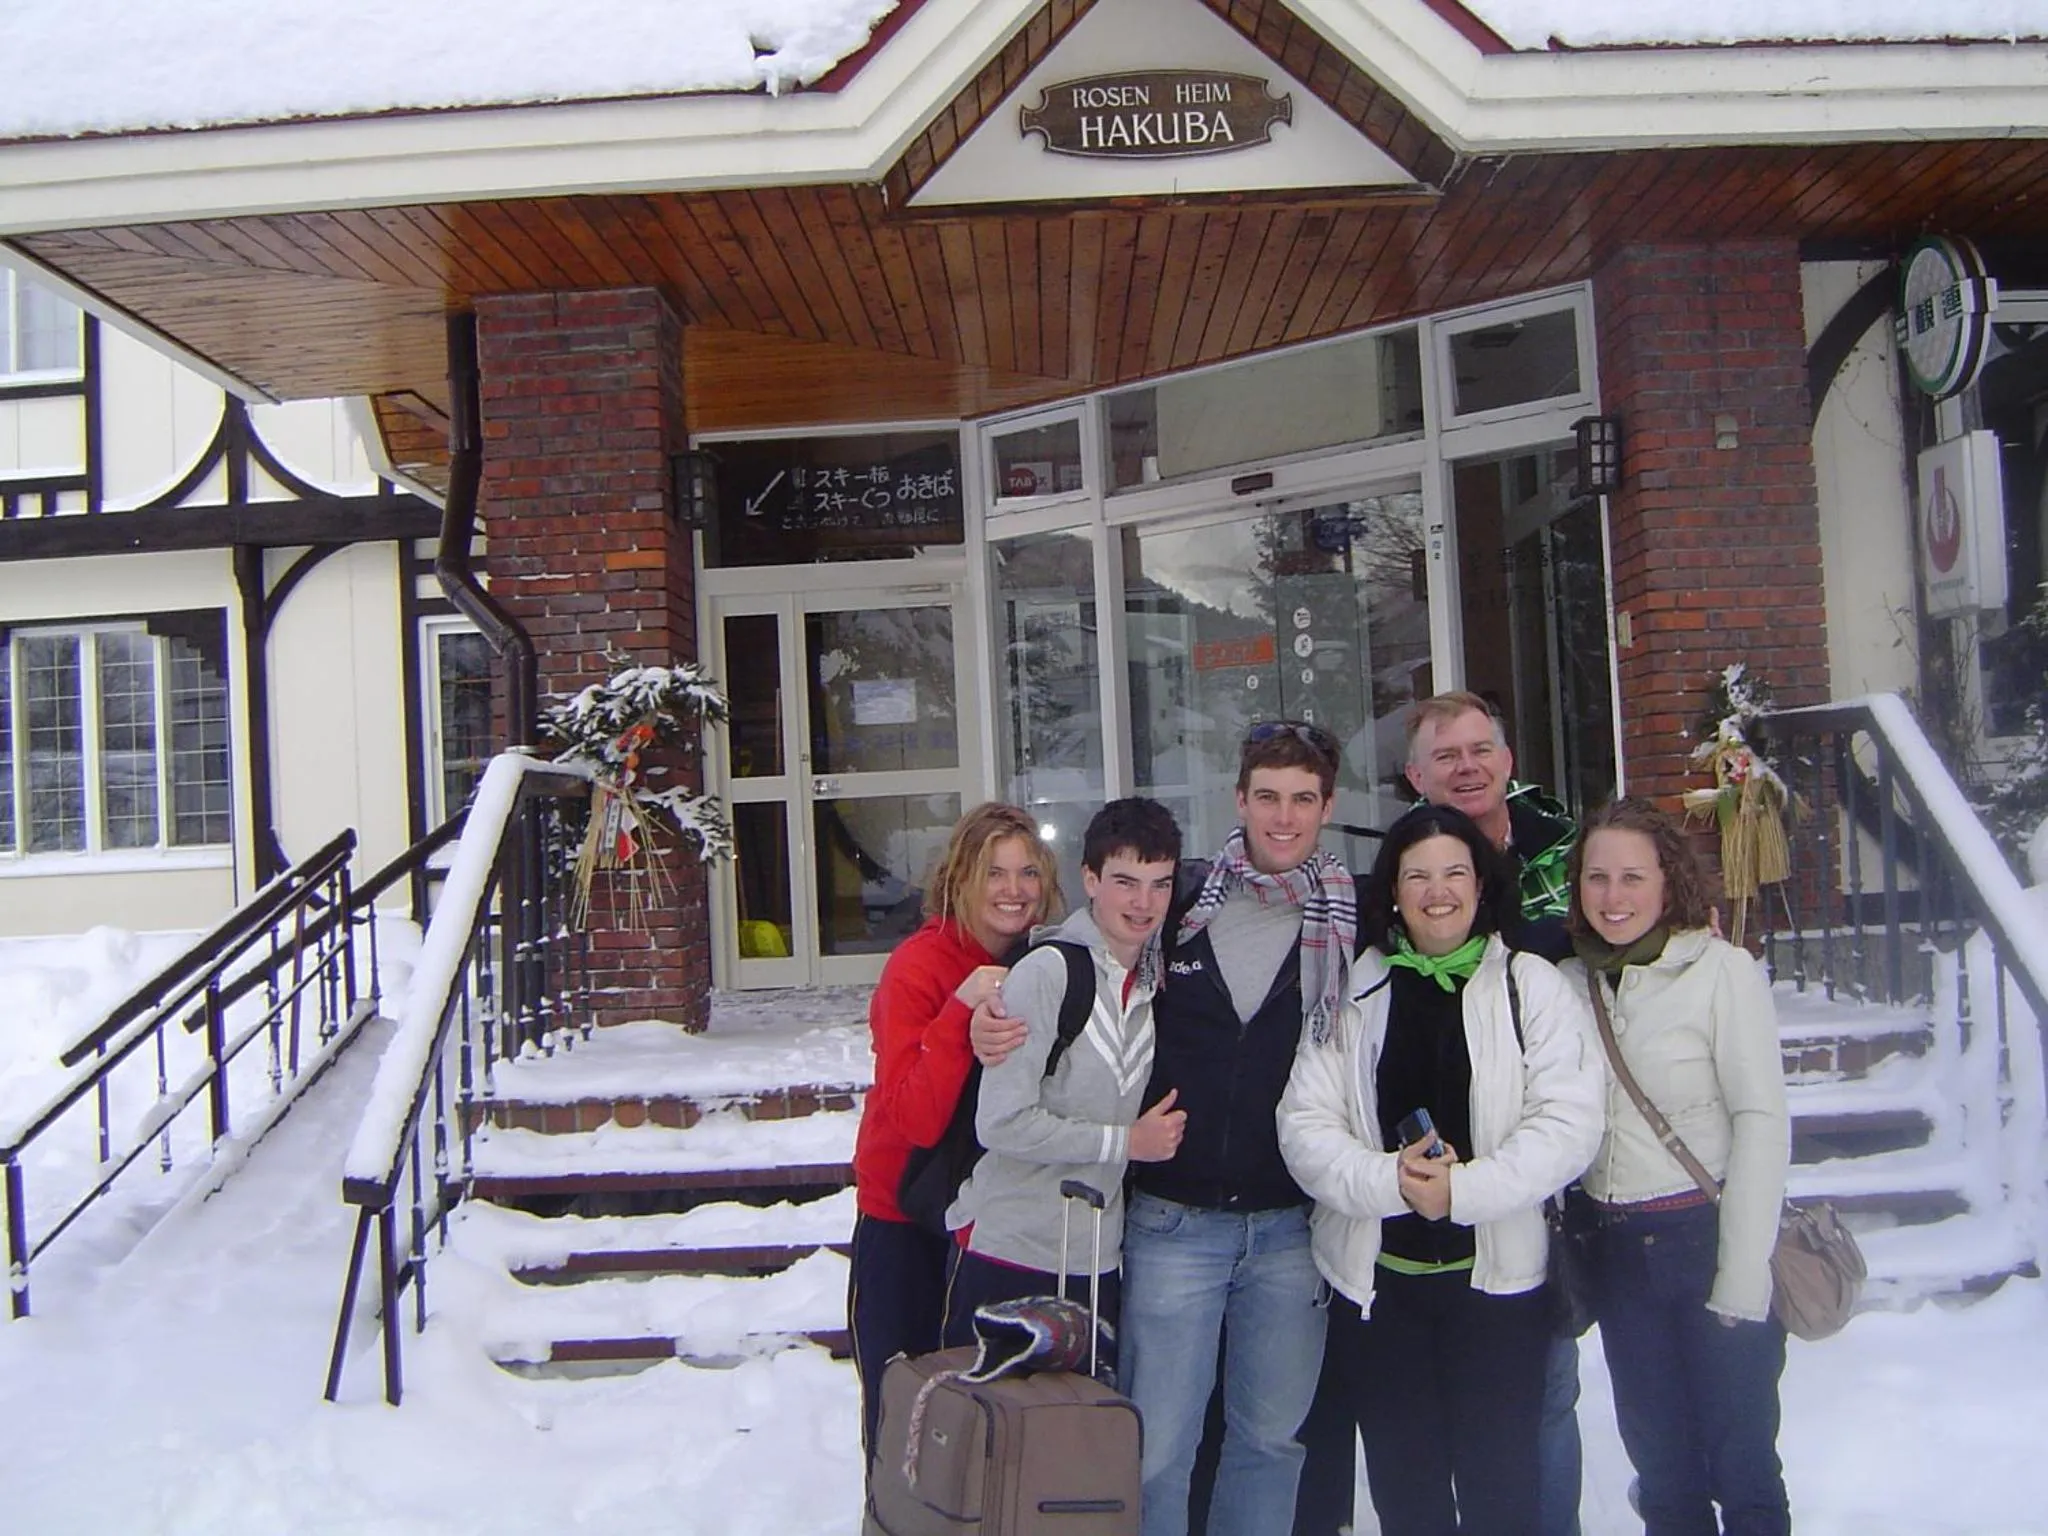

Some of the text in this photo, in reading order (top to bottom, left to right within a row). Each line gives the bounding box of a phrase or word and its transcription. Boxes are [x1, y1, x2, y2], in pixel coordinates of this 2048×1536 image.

[1073, 83, 1231, 108] ROSEN HEIM
[1081, 111, 1234, 148] HAKUBA
[813, 469, 955, 511] スキーくつ おきば
[814, 465, 890, 488] スキー板
